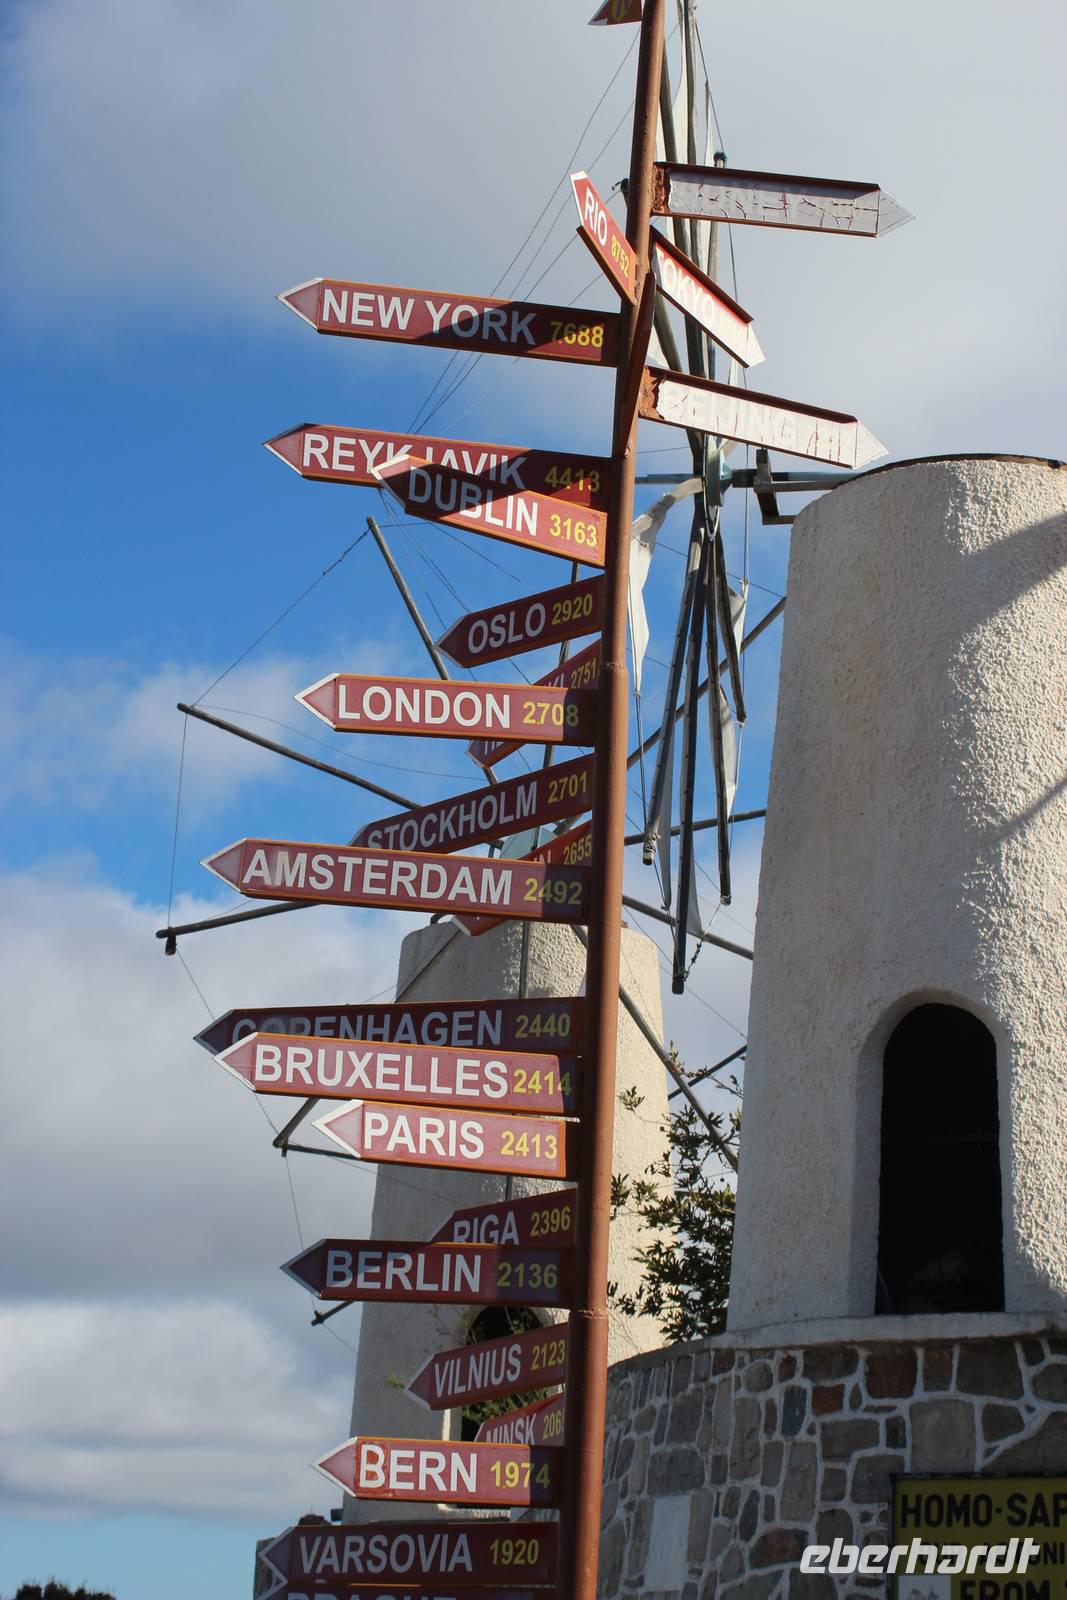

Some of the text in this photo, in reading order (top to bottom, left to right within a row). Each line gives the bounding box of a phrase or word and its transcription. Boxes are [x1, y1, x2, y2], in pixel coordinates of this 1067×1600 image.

[584, 186, 630, 278] RIO 8752
[322, 288, 415, 330] NEW
[425, 300, 537, 345] YORK
[408, 466, 538, 537] DUBLIN
[545, 465, 600, 492] 4413
[468, 593, 593, 653] OSLO 2920
[571, 657, 597, 689] 2751
[338, 684, 510, 729] LONDON
[367, 770, 588, 851] STOCKHOLM 2701
[242, 849, 512, 905] AMSTERDAM
[515, 1013, 571, 1039] 2440
[255, 1044, 508, 1099] BRUXELLES
[364, 1112, 484, 1159] PARIS
[453, 1206, 571, 1246] RIGA 2396
[326, 1250, 558, 1293] BERLIN 2136
[434, 1339, 566, 1399] VILNIUS 2123
[543, 1410, 564, 1441] 206
[359, 1443, 477, 1493] BERN
[300, 1534, 539, 1574] VARSOVIA 1920
